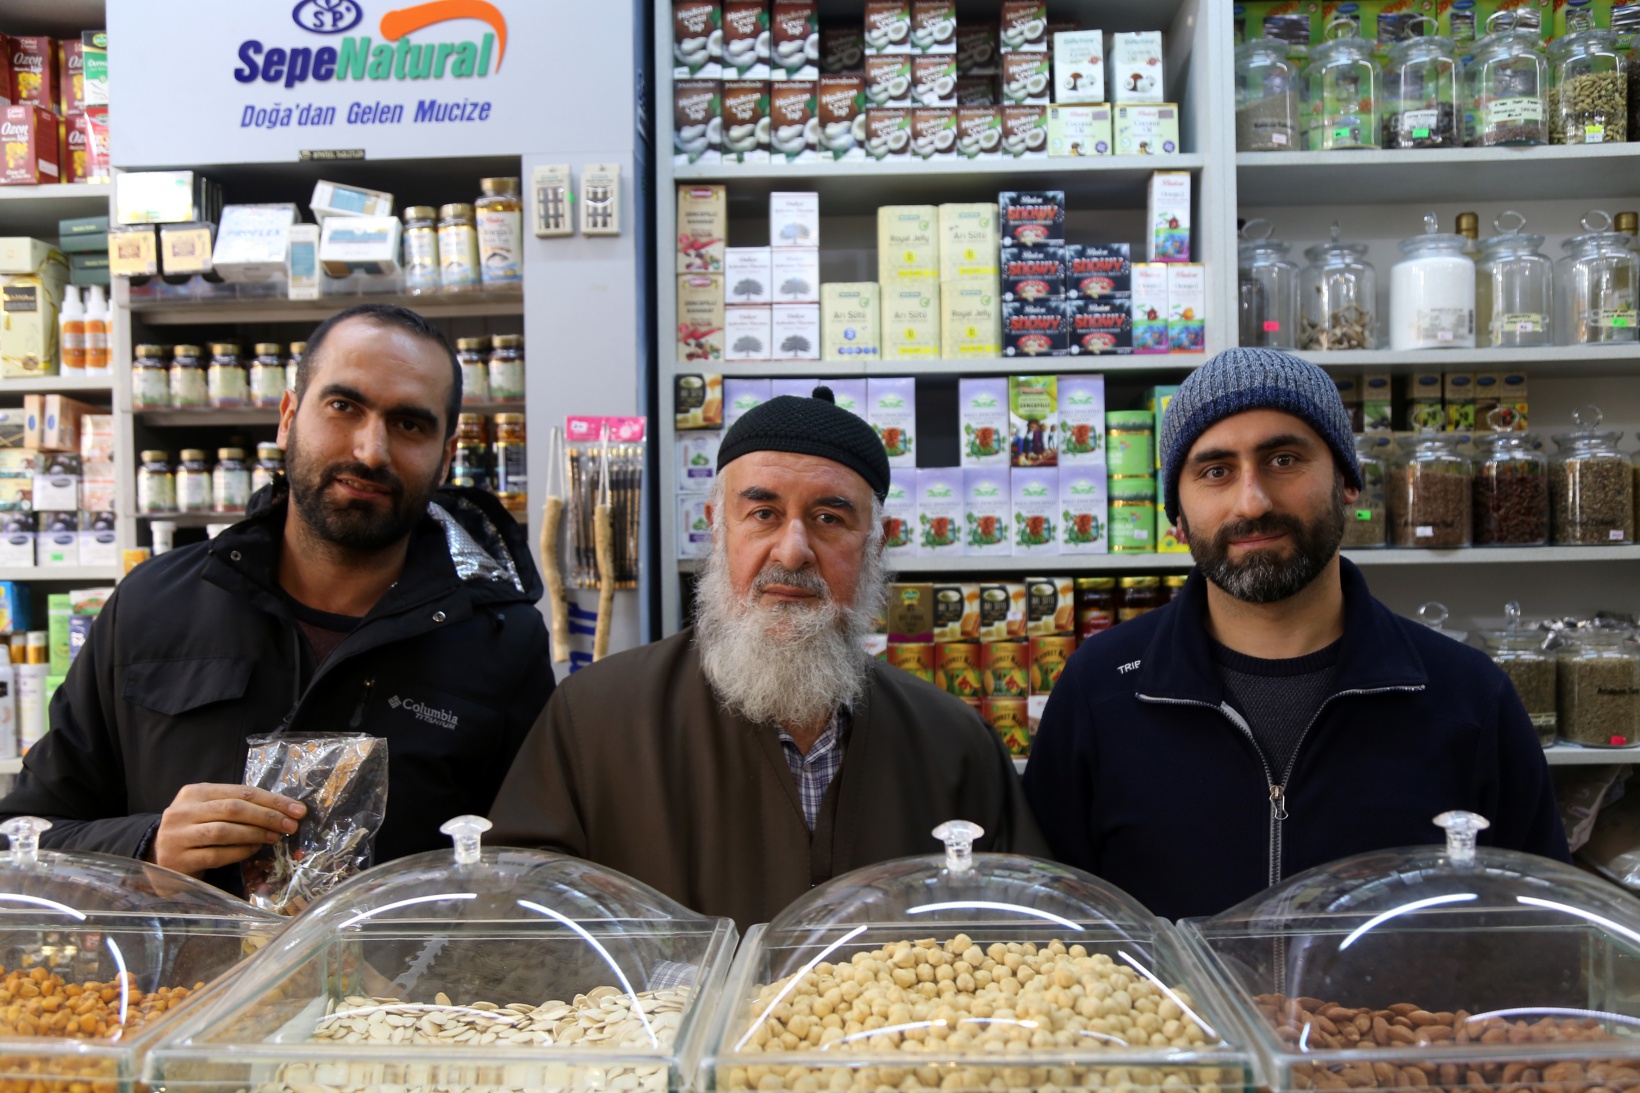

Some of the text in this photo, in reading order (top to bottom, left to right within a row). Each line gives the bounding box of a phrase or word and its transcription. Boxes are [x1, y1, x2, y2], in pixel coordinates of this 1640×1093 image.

[233, 32, 495, 89] SepeNatural
[240, 98, 492, 129] Doğa'dan Gelen Mucize
[402, 698, 458, 725] Columbia
[415, 713, 456, 730] TITANIUM
